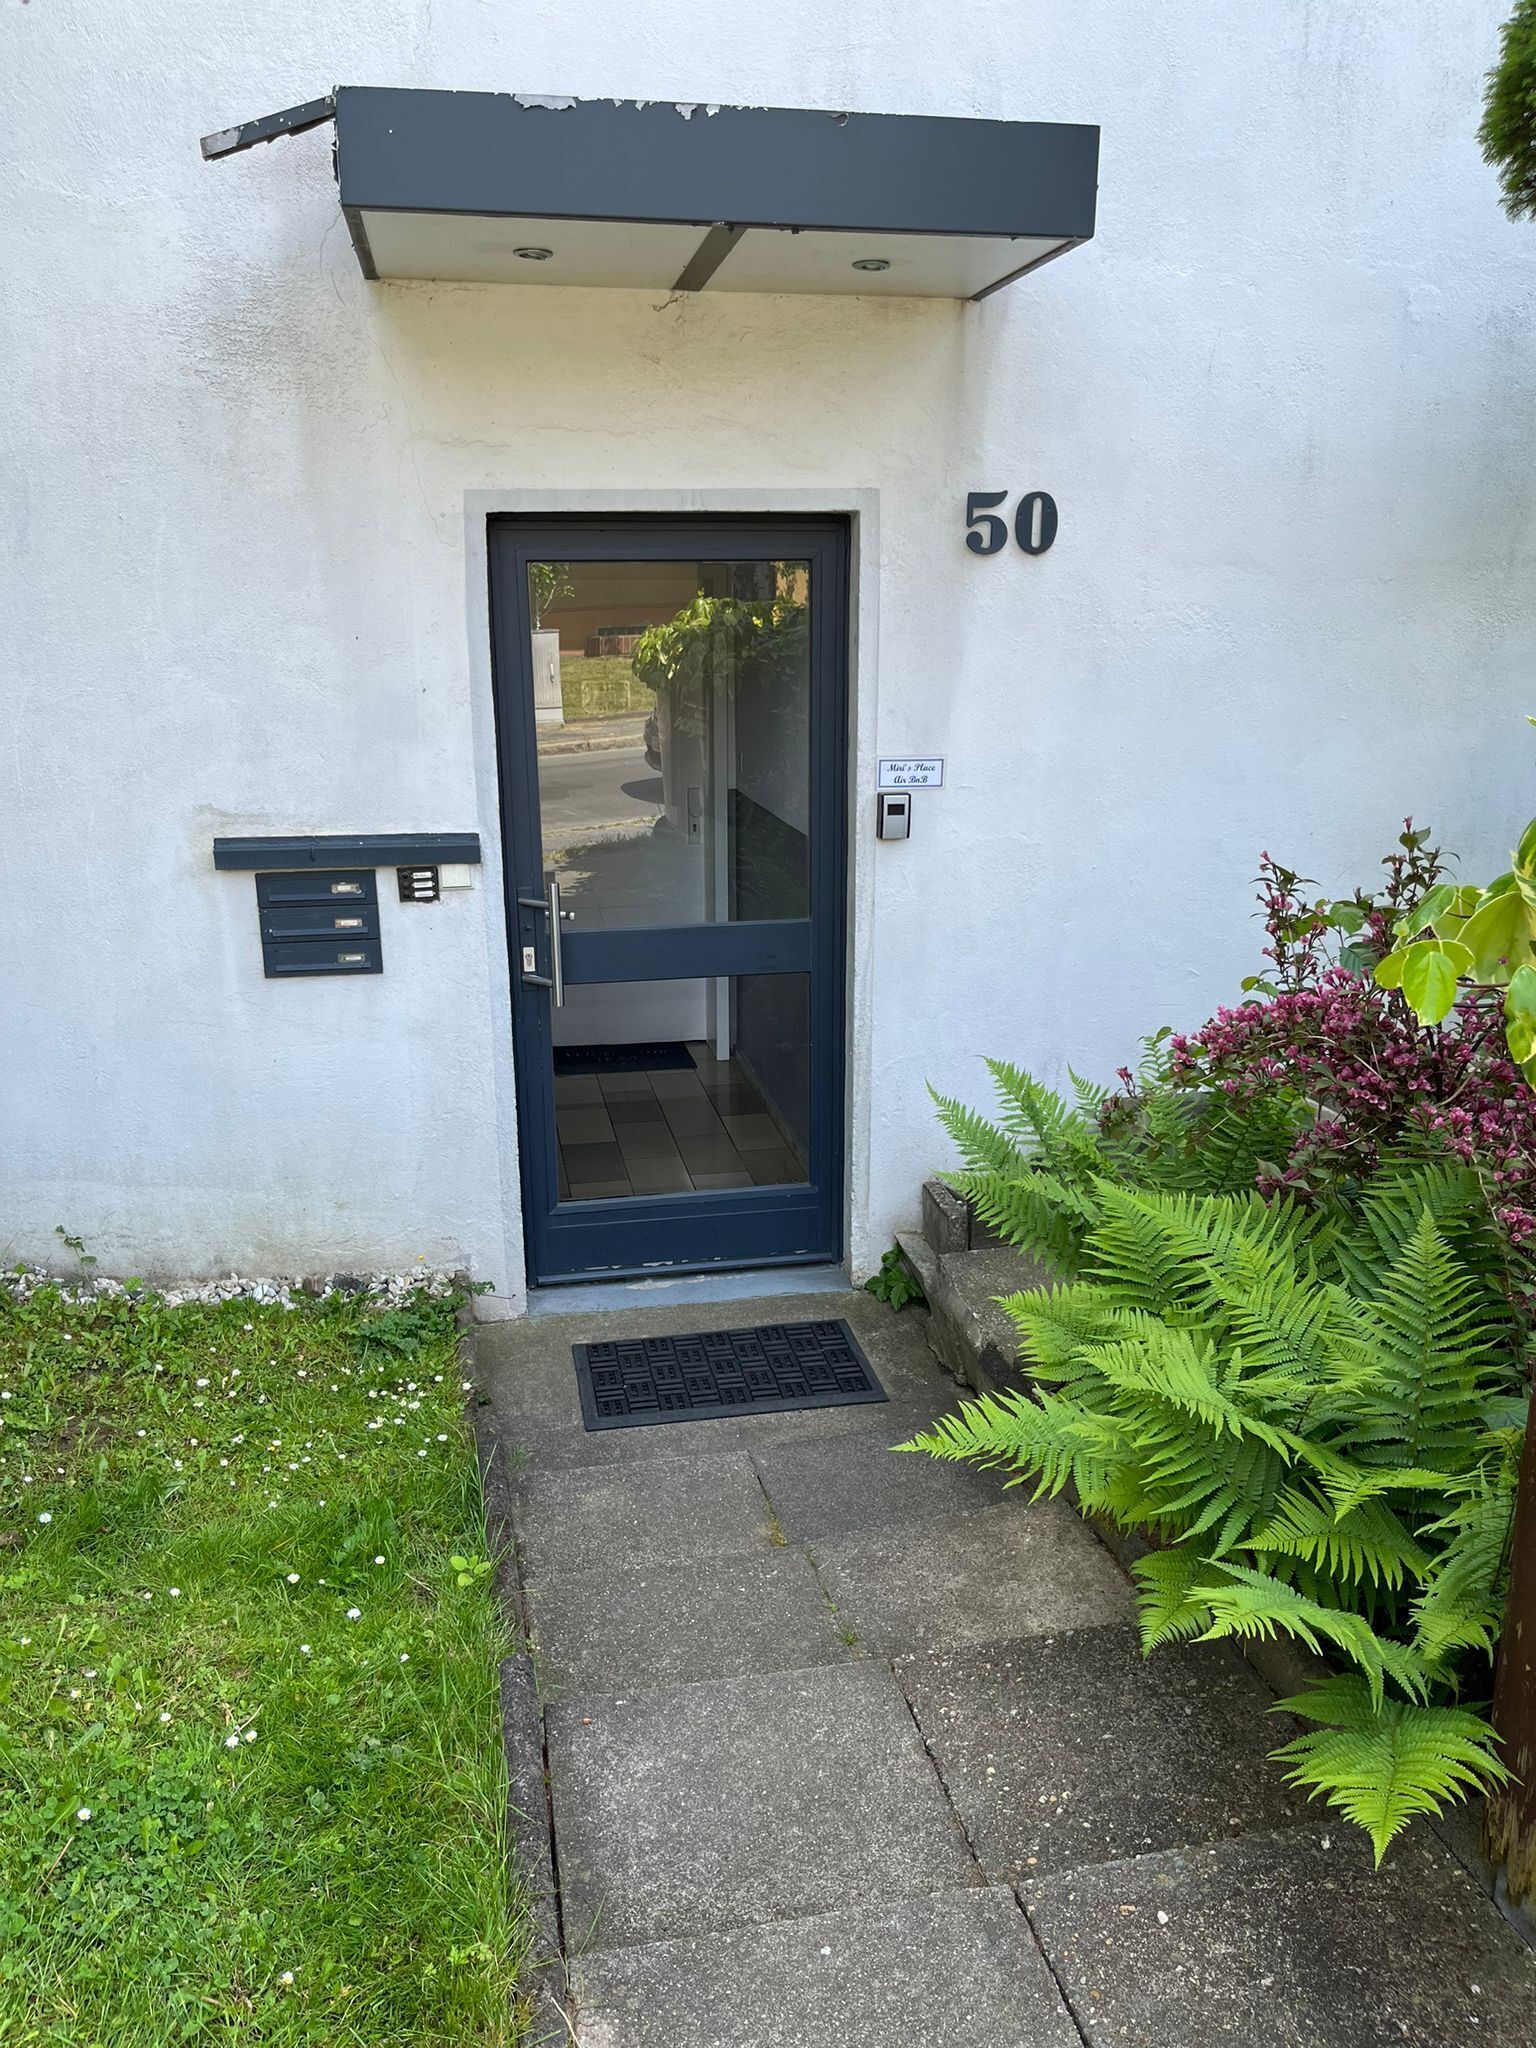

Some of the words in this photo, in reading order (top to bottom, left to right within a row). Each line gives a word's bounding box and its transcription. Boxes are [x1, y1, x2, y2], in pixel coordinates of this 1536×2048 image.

[966, 490, 1058, 555] 50
[913, 763, 936, 772] Place
[894, 775, 907, 784] Air
